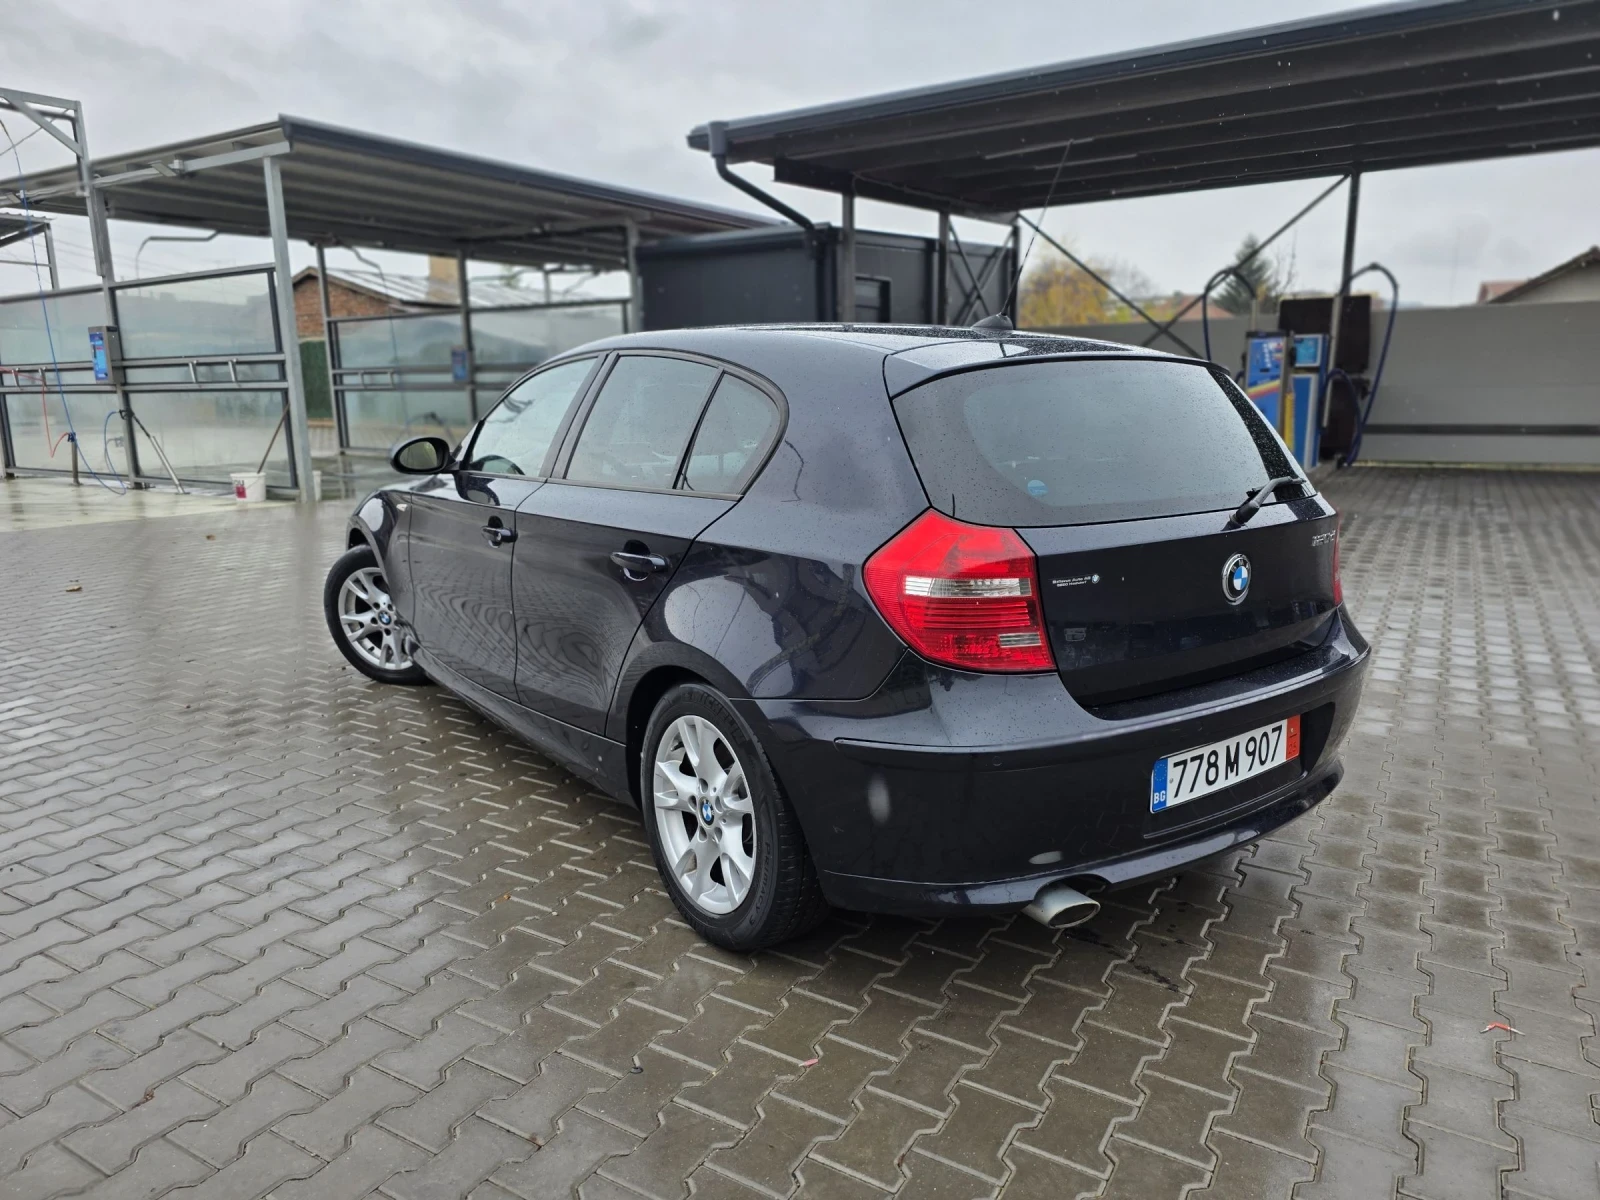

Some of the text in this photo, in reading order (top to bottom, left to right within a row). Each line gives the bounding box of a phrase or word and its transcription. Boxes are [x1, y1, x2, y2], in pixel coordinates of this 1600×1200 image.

[1153, 724, 1283, 804] BG 778 M 907
[756, 841, 771, 913] PRIMACY
